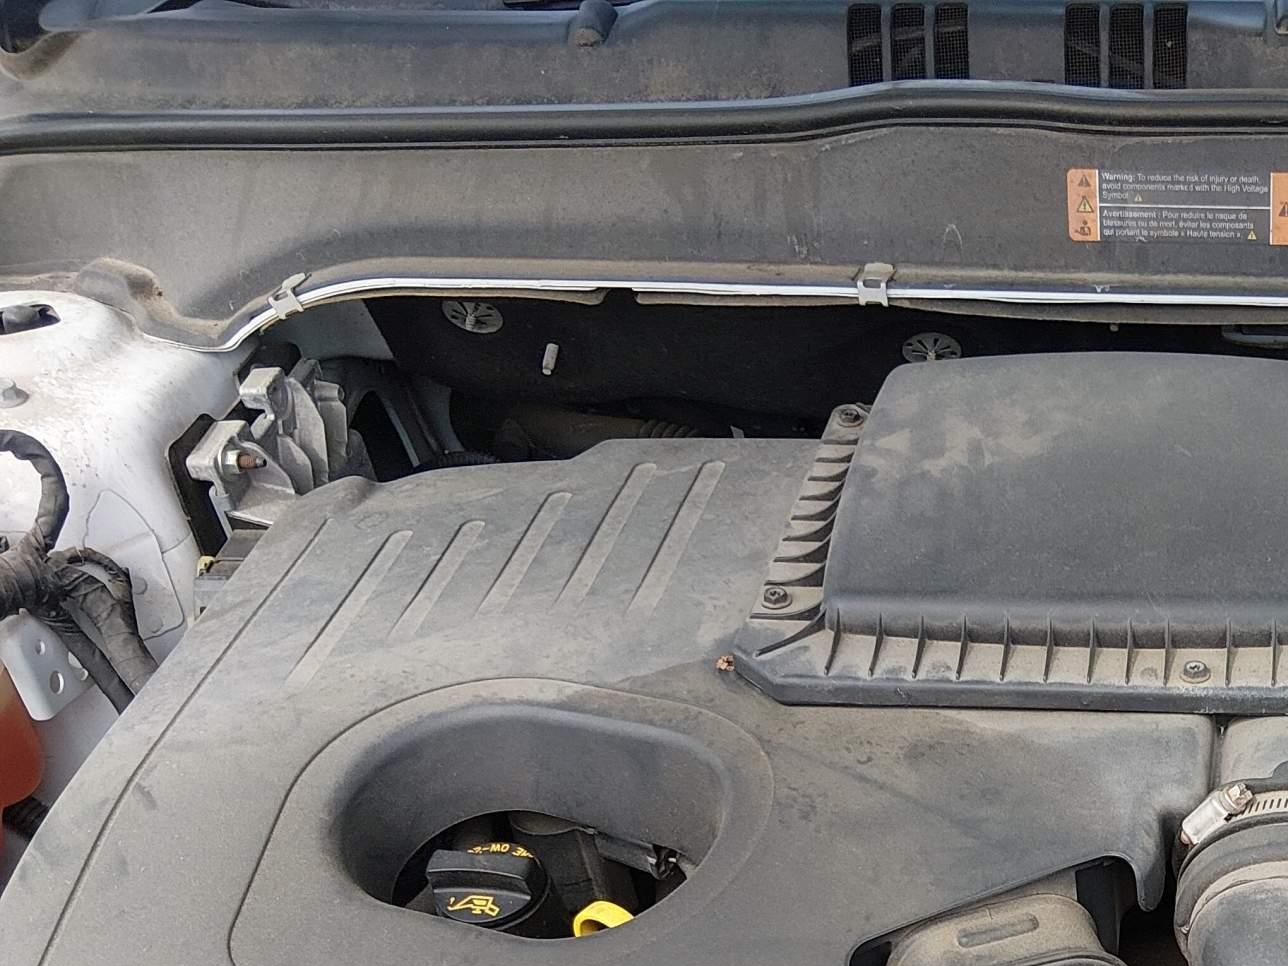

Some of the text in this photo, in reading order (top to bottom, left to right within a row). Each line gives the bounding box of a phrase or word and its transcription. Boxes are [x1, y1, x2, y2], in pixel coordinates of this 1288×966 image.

[1101, 172, 1136, 182] Warning:
[1137, 173, 1145, 181] To
[1147, 174, 1172, 182] reduce
[1173, 174, 1185, 182] the
[1186, 174, 1199, 182] risk
[1200, 174, 1209, 182] of
[1209, 175, 1228, 184] injury
[1102, 182, 1121, 190] avoid
[1122, 183, 1165, 192] components
[1167, 184, 1194, 192] marked
[1195, 184, 1210, 192] with
[1223, 185, 1241, 194] High
[1242, 185, 1269, 195] Voltage
[1102, 209, 1157, 218] Avertissement
[1162, 210, 1180, 219] Pour
[1215, 212, 1236, 221] risque
[1199, 220, 1211, 228] les
[1211, 222, 1254, 231] composants
[1150, 230, 1180, 239] symbole
[1186, 230, 1208, 239] Haute
[1209, 231, 1235, 239] tension
